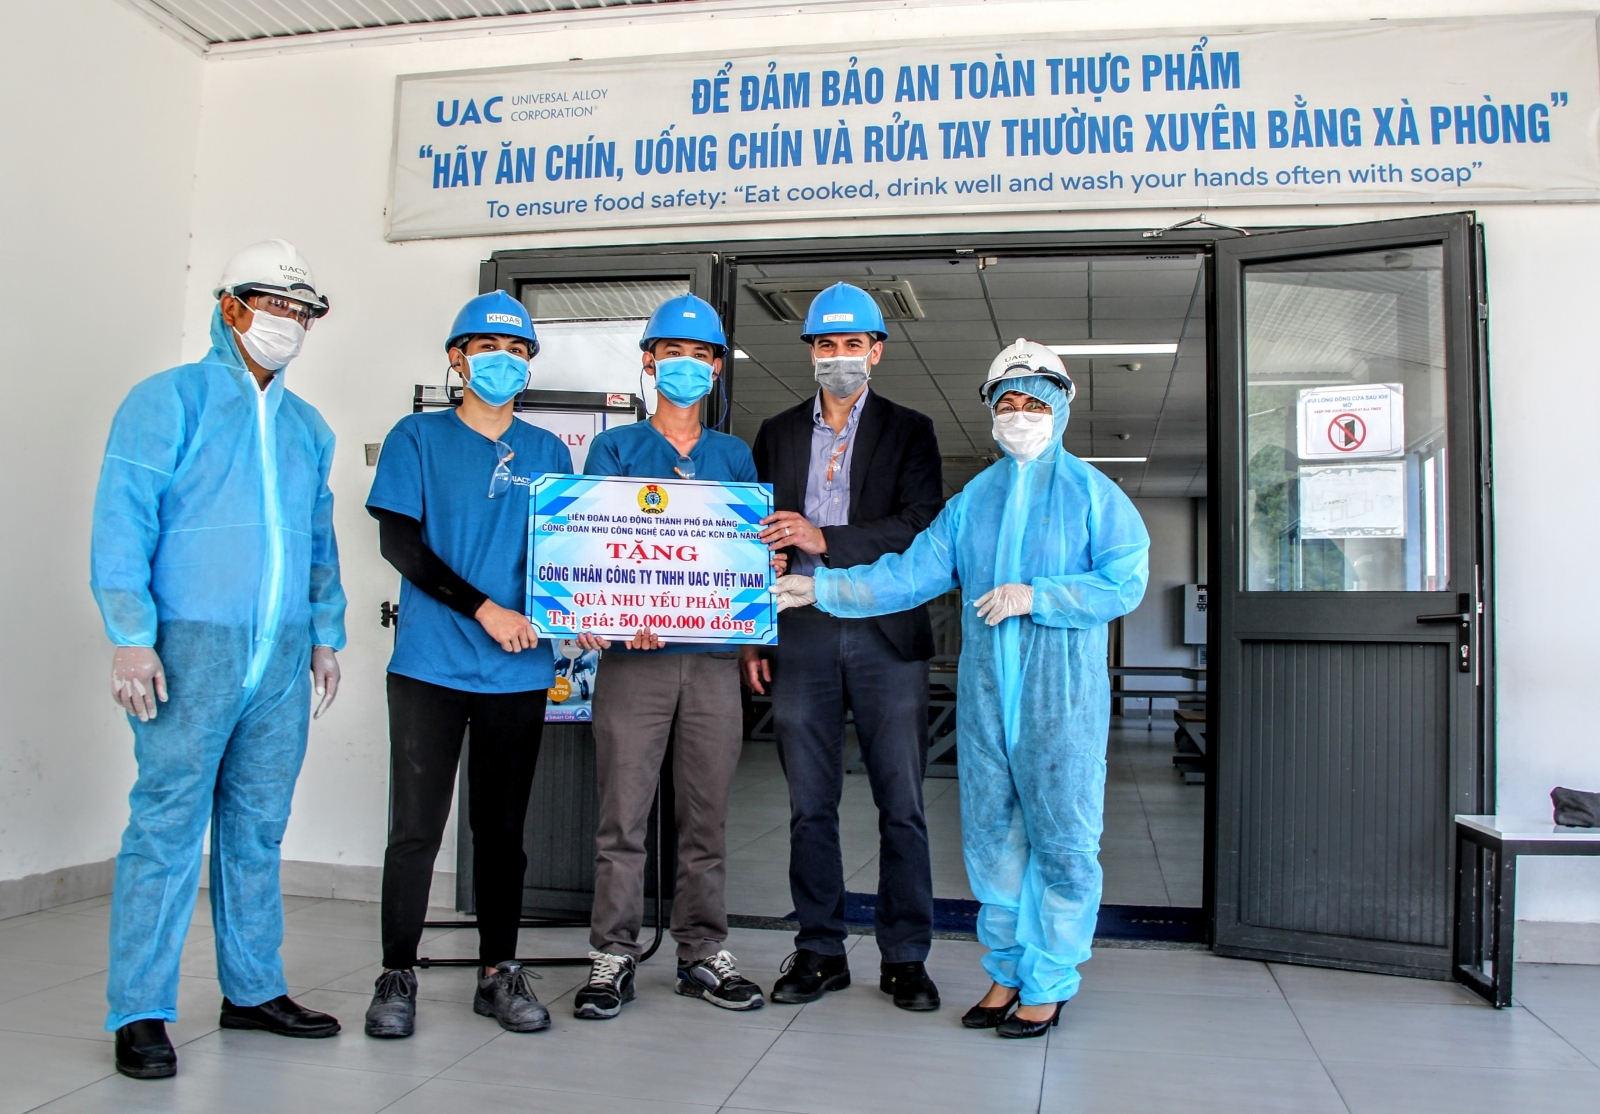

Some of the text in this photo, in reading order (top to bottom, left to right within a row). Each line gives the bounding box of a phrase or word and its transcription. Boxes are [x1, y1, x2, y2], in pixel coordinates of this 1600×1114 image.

[691, 36, 1241, 115] ĐỂ ĐẢM BẢO AN TOÀN THỰC PHẨM
[511, 89, 608, 106] UNIVERSAL ALLOY
[436, 96, 504, 127] UAC
[494, 141, 536, 185] ĂN
[545, 134, 624, 182] CHÍN,
[635, 124, 717, 176] UỐNG
[728, 123, 803, 170] CHÍN
[813, 120, 853, 166] VÀ
[864, 111, 929, 163] RỬA
[938, 120, 991, 160] TAY
[1001, 107, 1134, 157] THƯỜNG
[1145, 103, 1256, 152] XUYÊN
[1268, 94, 1362, 149] BẰNG
[1373, 98, 1420, 147] XÀ
[487, 161, 1482, 219] To ensure food safety: “Eat cooked, drink well and wash your hands often with soap”
[279, 264, 307, 276] UACV
[1004, 353, 1034, 363] UACV
[542, 523, 565, 532] CÔNG
[566, 523, 589, 533] ĐOÀN
[591, 526, 609, 534] KHU
[611, 525, 633, 535] CÔNG
[635, 526, 658, 537] NGHỆ
[659, 528, 676, 537] CAO
[678, 527, 689, 537] VÀ
[691, 528, 706, 538] CÁC
[708, 530, 725, 539] KCN
[727, 530, 738, 539] ĐÀ
[567, 512, 585, 521] LIÊN
[587, 513, 610, 523] ĐOÀN
[612, 515, 628, 523] LAO
[629, 514, 653, 525] ĐỘNG
[655, 516, 682, 525] THÀNH
[684, 516, 701, 526] PHỐ
[702, 517, 714, 526] ĐÀ
[606, 539, 699, 564] TẶNG
[538, 562, 764, 590] CÔNG NHÂN CÔNG TY TNHH UAC VIỆT NAM
[573, 589, 731, 609] QUÀ NHU YẾU PHẨM
[548, 610, 755, 634] Trị giá: 50.000.000 đồng
